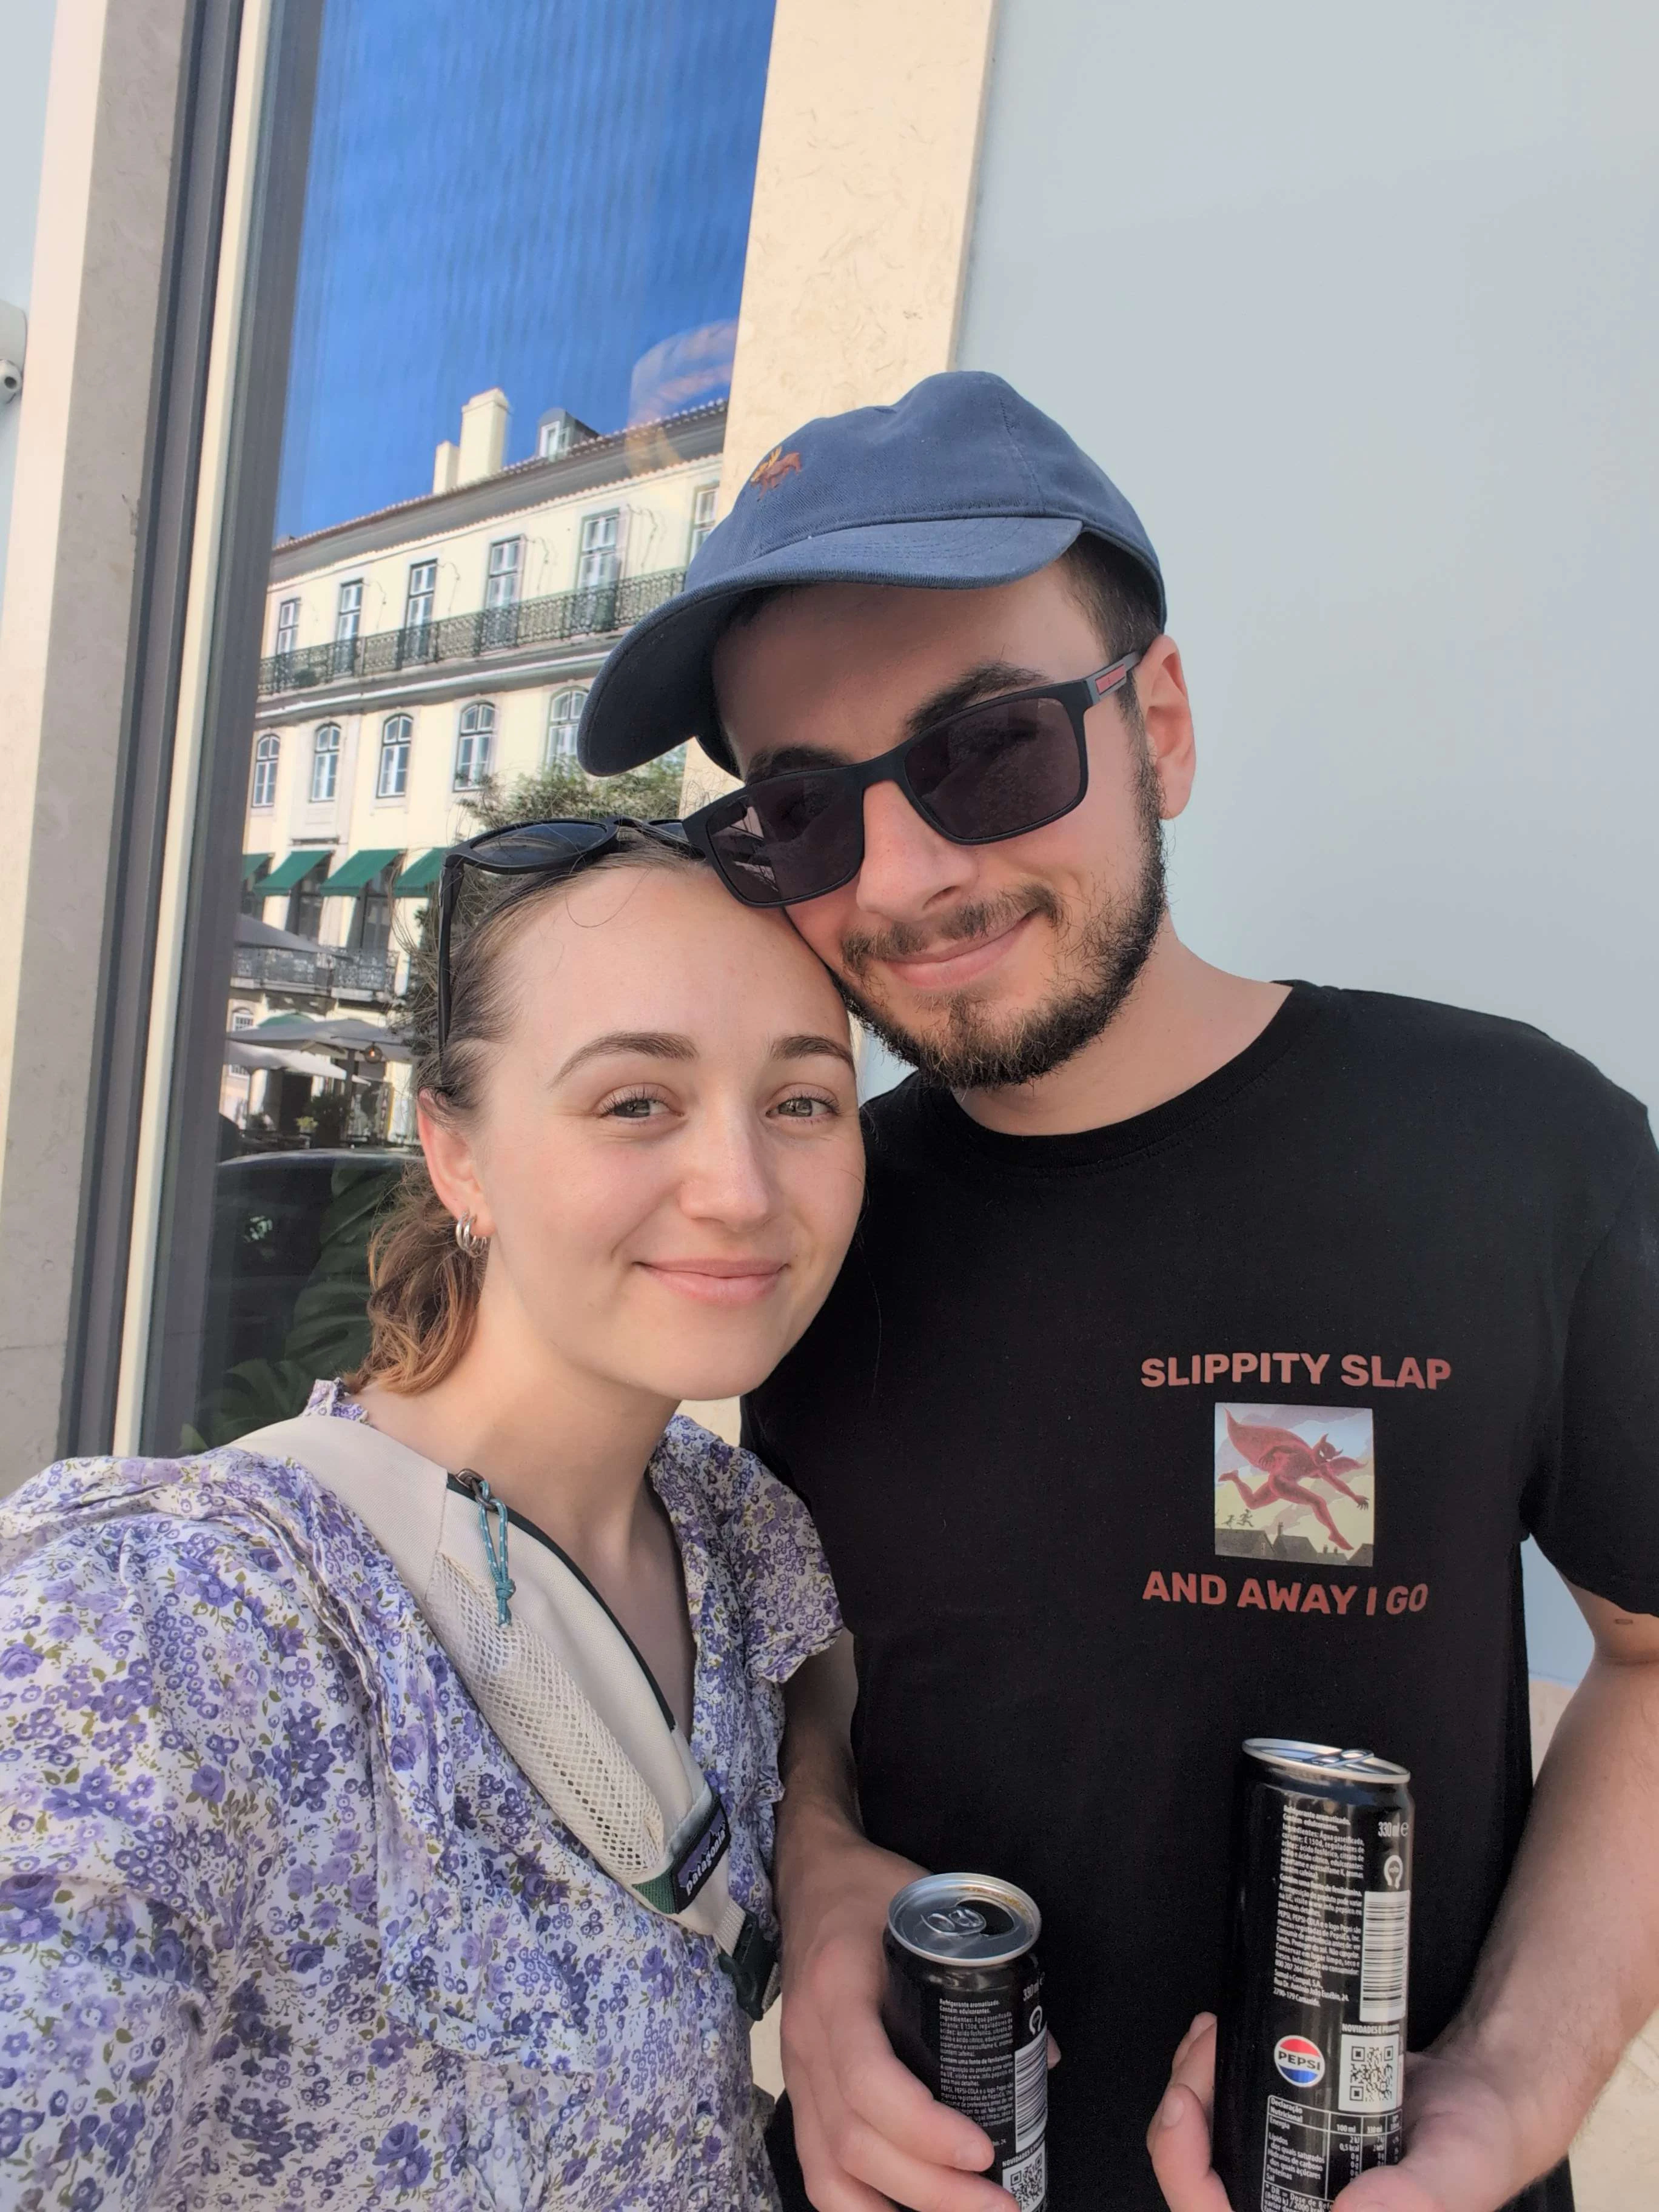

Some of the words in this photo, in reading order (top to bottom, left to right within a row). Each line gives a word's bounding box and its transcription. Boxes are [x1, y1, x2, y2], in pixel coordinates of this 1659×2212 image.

[1141, 1352, 1330, 1388] SLIPPITY
[1341, 1355, 1452, 1390] SLAP
[1142, 1571, 1227, 1605] AND
[1237, 1578, 1357, 1615] AWAY
[1366, 1587, 1378, 1616] I
[1386, 1583, 1429, 1615] GO
[686, 1829, 726, 1895] patagonia
[1342, 2023, 1378, 2034] NOVIDADES
[1278, 2051, 1320, 2071] PEPSI
[1270, 2116, 1290, 2130] Energia
